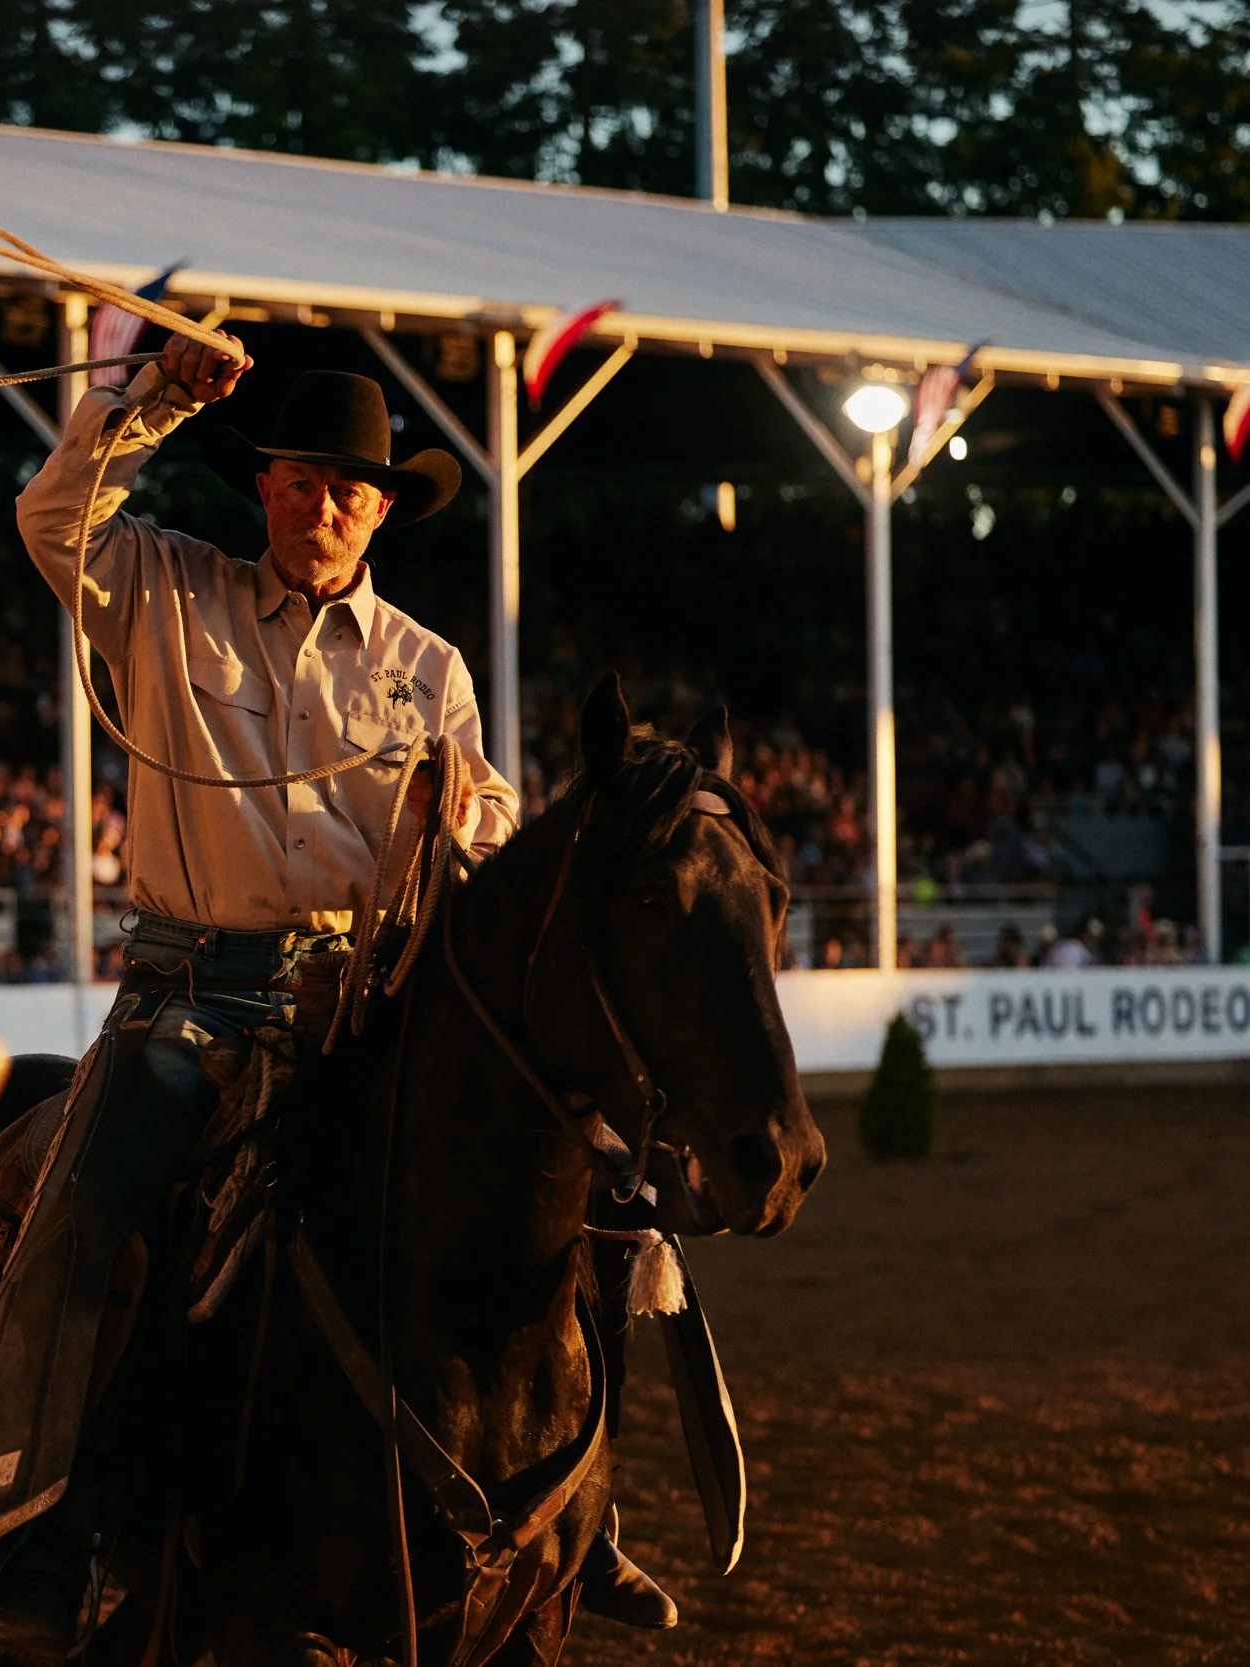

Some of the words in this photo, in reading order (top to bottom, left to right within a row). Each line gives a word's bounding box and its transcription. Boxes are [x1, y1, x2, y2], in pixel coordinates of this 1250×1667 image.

[370, 671, 384, 683] ST.
[384, 669, 408, 680] PAUL
[410, 675, 435, 701] RODEO
[911, 992, 974, 1043] ST.
[990, 989, 1097, 1038] PAUL
[1111, 984, 1250, 1036] RODEO
